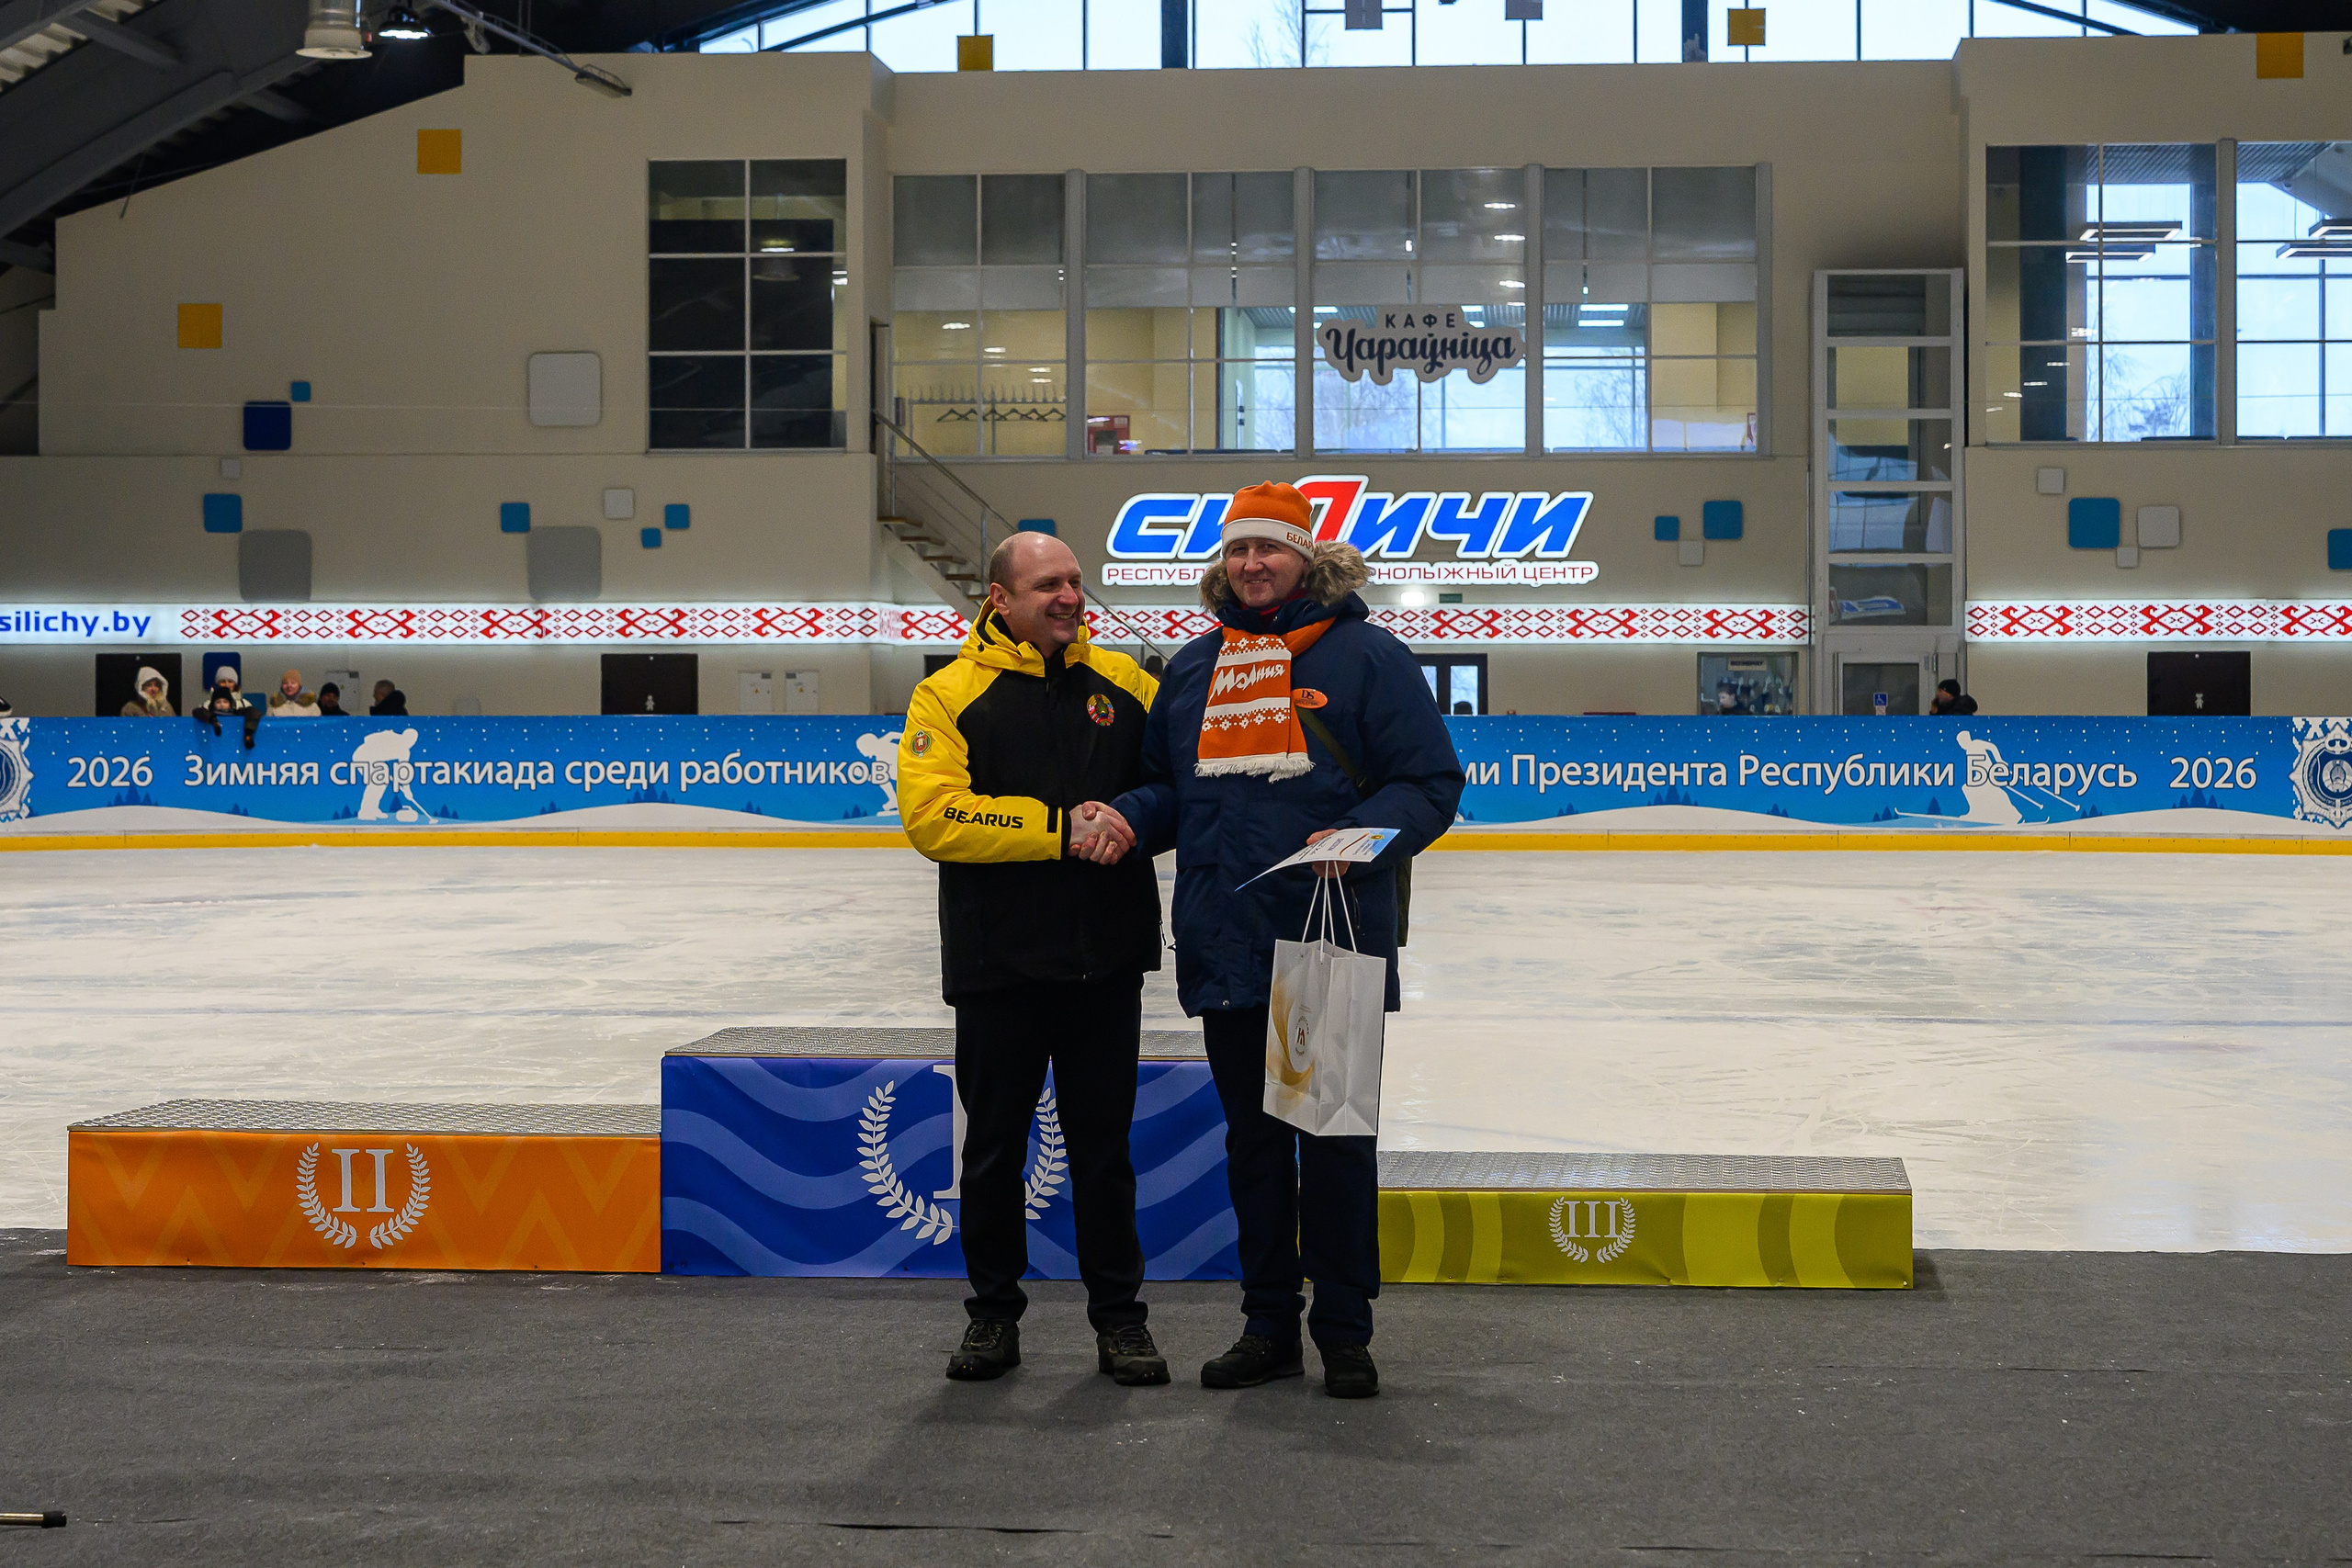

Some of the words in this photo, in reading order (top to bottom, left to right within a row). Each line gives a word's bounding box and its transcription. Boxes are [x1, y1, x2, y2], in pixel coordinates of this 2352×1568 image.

[1385, 312, 1456, 330] КАФЕ
[1325, 328, 1517, 377] Чараўніца
[1106, 568, 1204, 581] РЕСПУБЛ
[1373, 563, 1517, 580] НОЛЫЖНЫЙ
[1523, 567, 1594, 581] ЦЕНТР
[0, 611, 152, 637] silichy.by
[1205, 663, 1287, 706] Молния
[1301, 689, 1315, 700] DS
[67, 755, 154, 788] 2026
[184, 753, 319, 787] Зимняя
[330, 761, 554, 794] спартакиада
[564, 761, 670, 794] среди
[680, 751, 890, 794] работников
[1511, 754, 1727, 795] Президента
[1739, 753, 1954, 796] Республики
[1966, 755, 2138, 797] Беларусь
[2169, 757, 2257, 789] 2026
[332, 1147, 395, 1214] II
[1565, 1200, 1621, 1238] III
